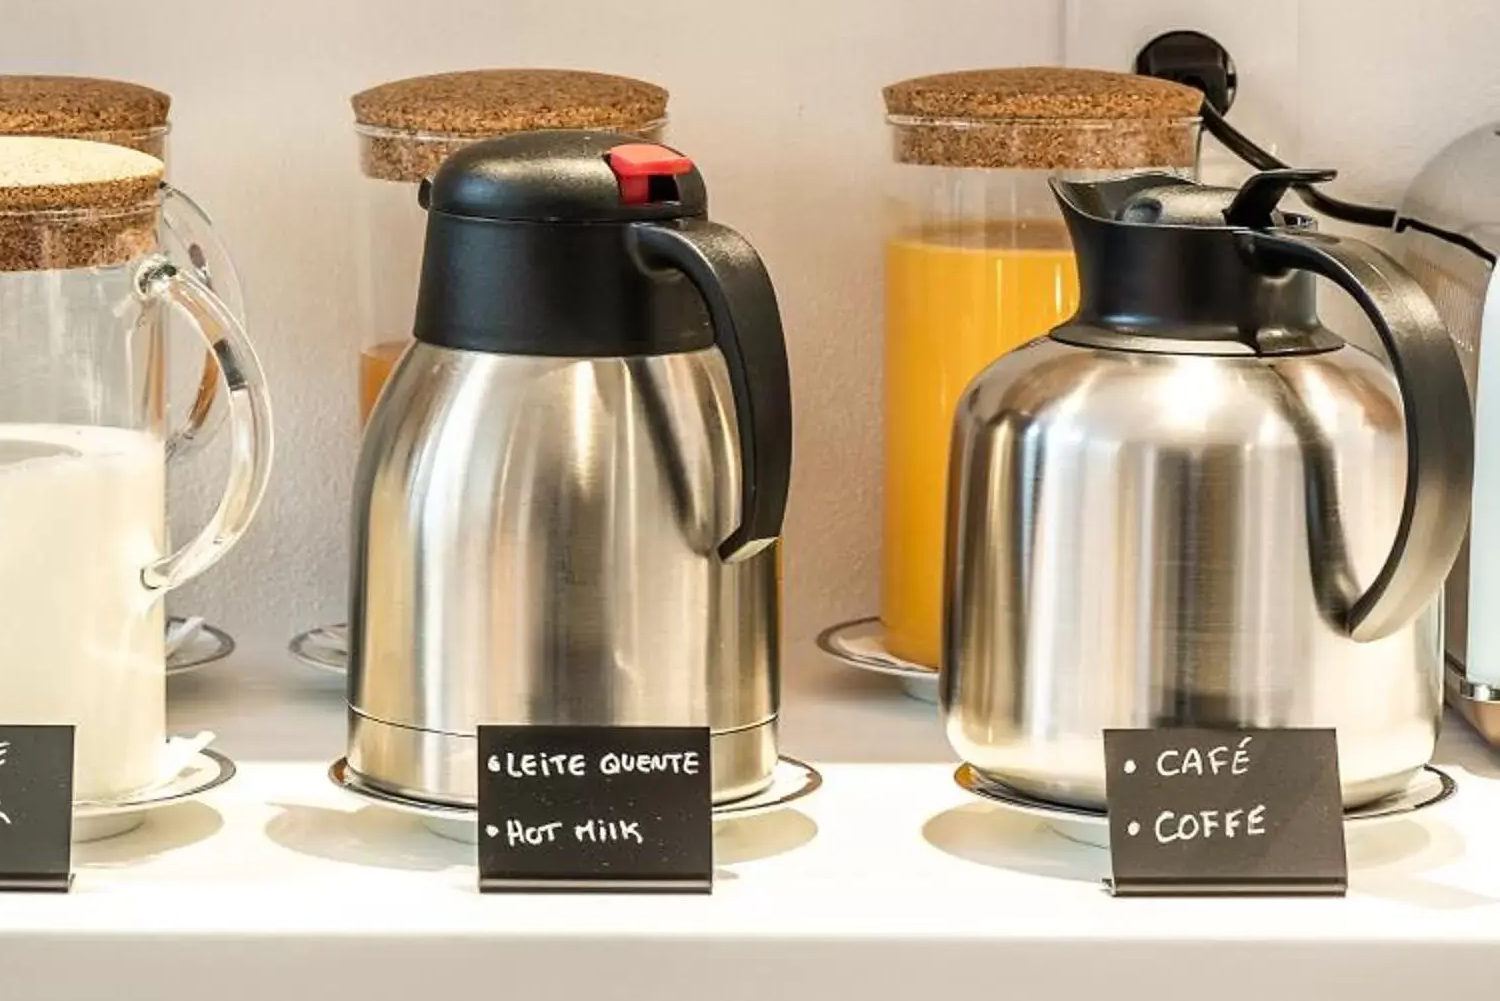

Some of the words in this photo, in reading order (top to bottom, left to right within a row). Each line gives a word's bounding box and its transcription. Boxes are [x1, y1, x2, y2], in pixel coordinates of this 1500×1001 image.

[600, 751, 699, 775] QUENTE
[1156, 736, 1252, 776] CAFÉ
[506, 819, 563, 847] HOT
[1155, 804, 1266, 843] COFFE
